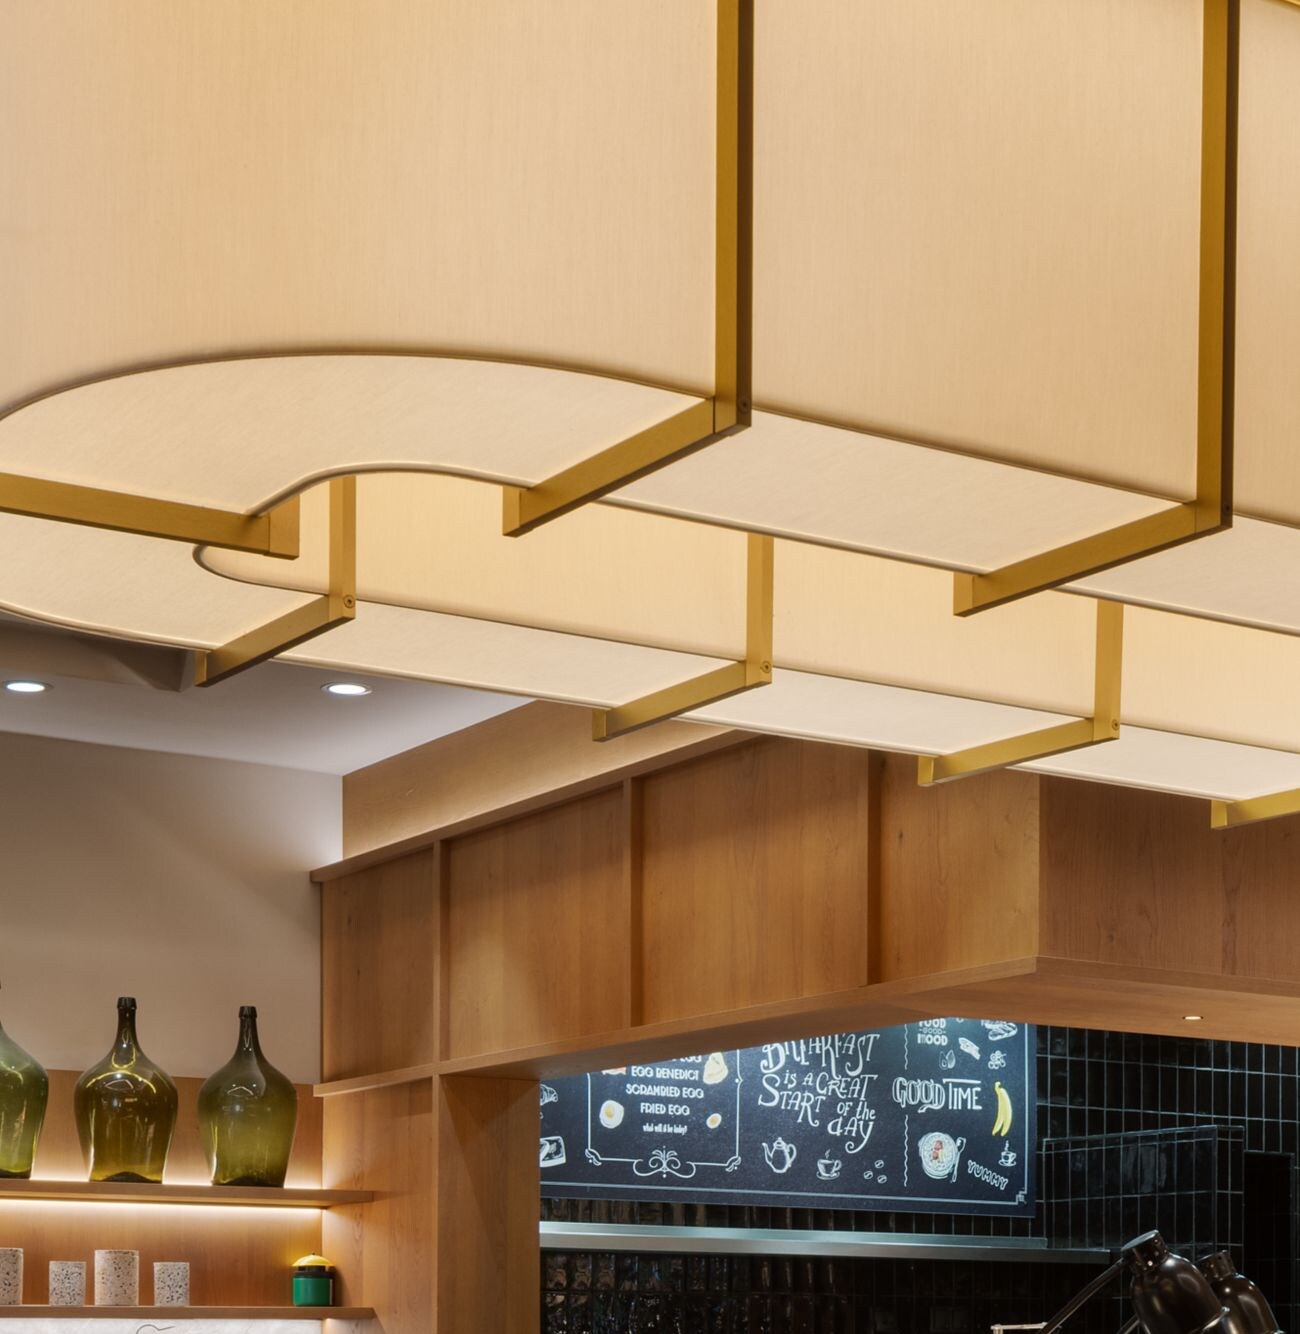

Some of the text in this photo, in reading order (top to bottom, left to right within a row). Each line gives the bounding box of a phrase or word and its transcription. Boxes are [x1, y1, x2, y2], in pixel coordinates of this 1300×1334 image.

[919, 1018, 946, 1028] FOOD
[917, 1033, 948, 1046] MOOD
[680, 1054, 702, 1063] GG
[631, 1066, 699, 1080] EGG BENEDICT
[626, 1084, 704, 1098] SCRAMBLED EGG
[816, 1071, 878, 1101] GREAT
[758, 1073, 826, 1127] START
[892, 1076, 983, 1113] GOOD TIME
[640, 1103, 690, 1115] FRIED EGG
[967, 1159, 1009, 1191] YUMMY
